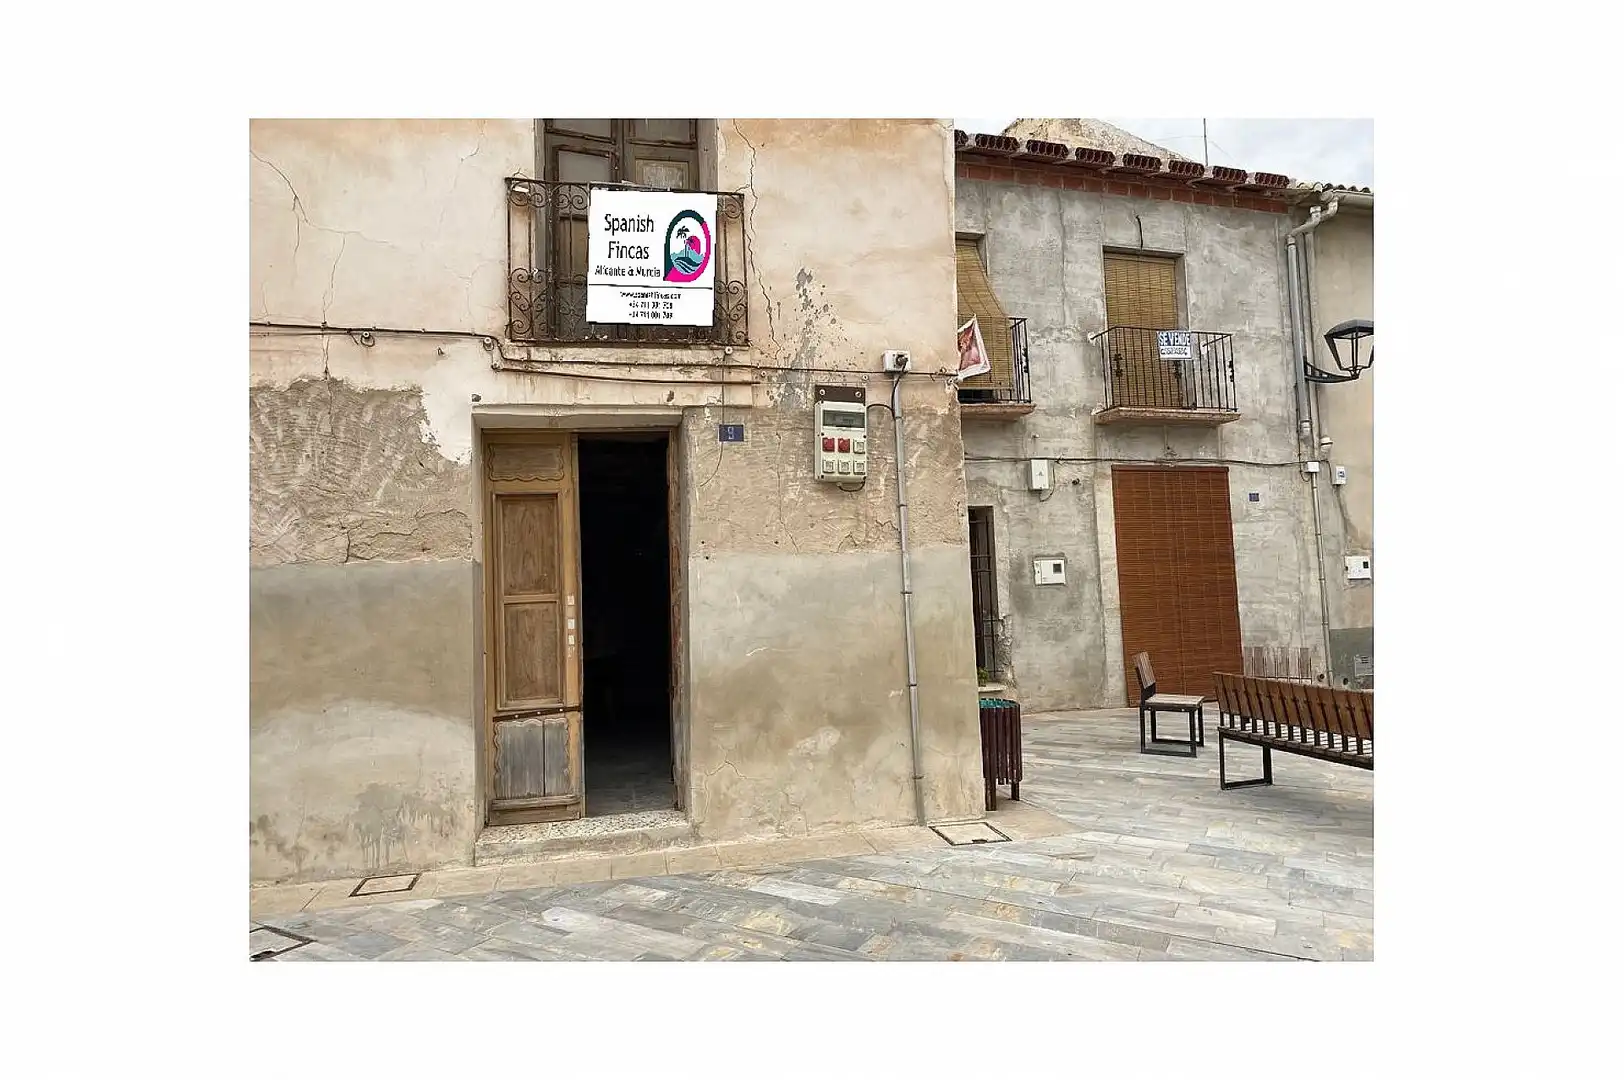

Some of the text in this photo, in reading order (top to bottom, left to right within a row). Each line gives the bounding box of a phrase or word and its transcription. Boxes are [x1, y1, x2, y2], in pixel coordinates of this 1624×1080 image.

[604, 213, 654, 236] Spanish
[607, 241, 650, 260] Fincas
[594, 265, 626, 277] Alicante
[635, 265, 661, 278] Murcia
[1159, 331, 1190, 347] SE VENDE
